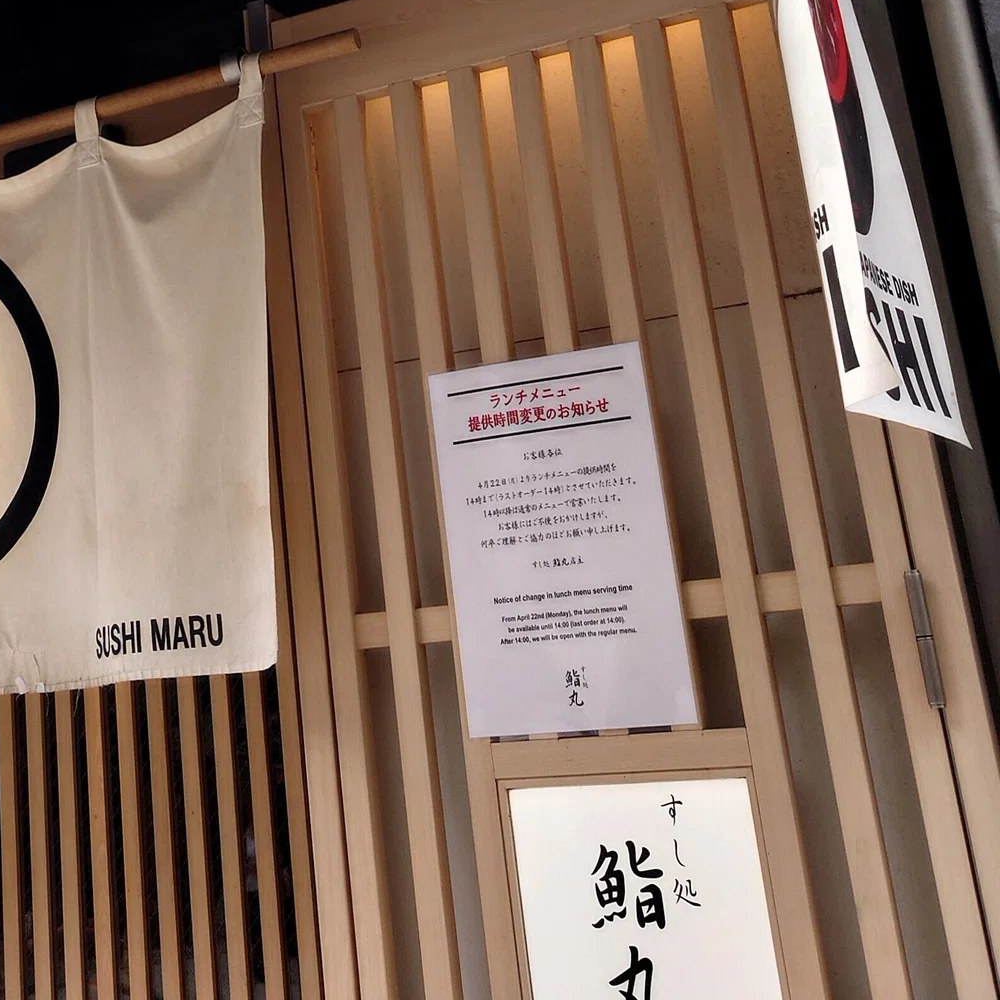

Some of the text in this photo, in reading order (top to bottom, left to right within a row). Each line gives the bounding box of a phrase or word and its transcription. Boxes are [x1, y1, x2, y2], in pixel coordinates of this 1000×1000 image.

[891, 274, 920, 307] DISH
[490, 385, 581, 409] ランチメニュー
[467, 398, 610, 433] 提供時間変更のお知らせ
[494, 596, 513, 604] Notice
[523, 593, 545, 601] change
[554, 590, 572, 598] lunch
[593, 586, 617, 594] serving
[618, 584, 633, 592] time
[516, 624, 540, 632] available
[570, 620, 583, 628] (last
[517, 614, 530, 622] April
[531, 612, 544, 620] 22nd
[96, 613, 224, 659] SUSHI MARU
[565, 669, 585, 707] 鮨丸
[660, 793, 702, 908] すし処
